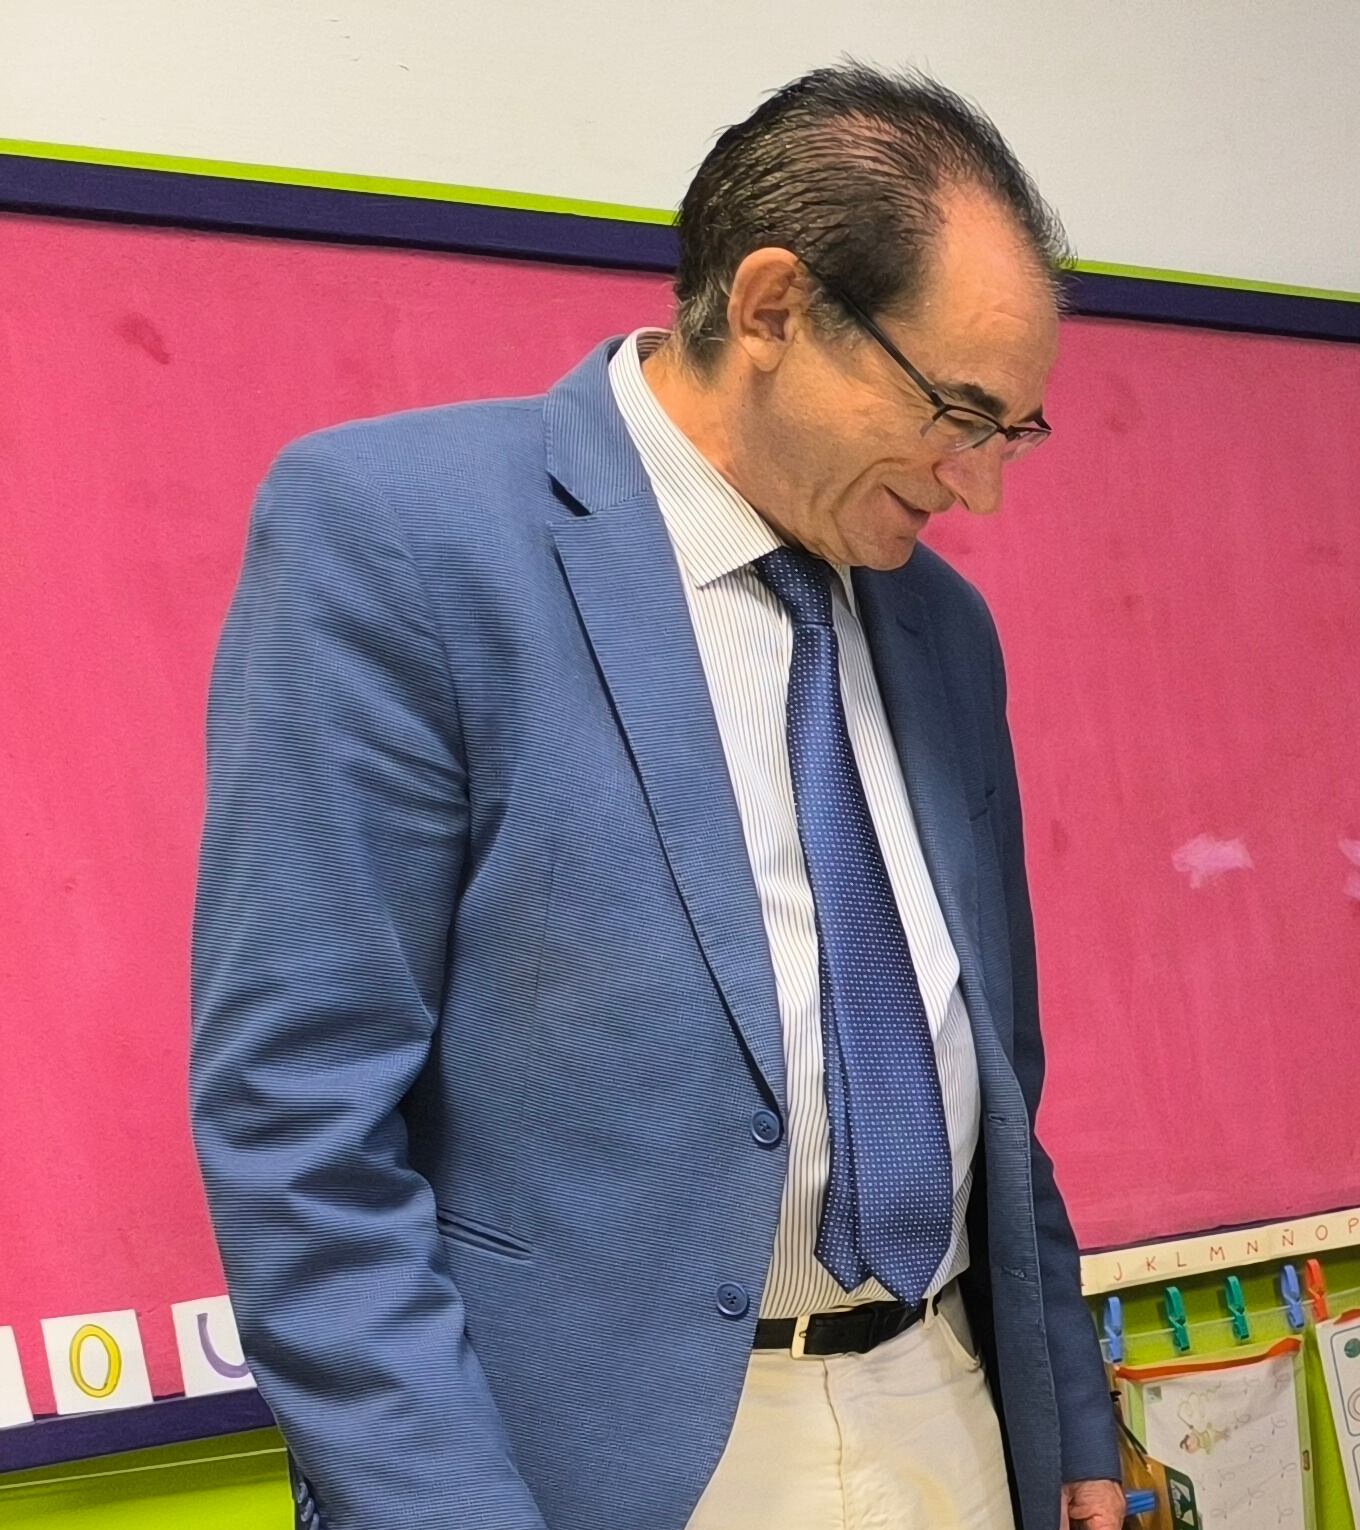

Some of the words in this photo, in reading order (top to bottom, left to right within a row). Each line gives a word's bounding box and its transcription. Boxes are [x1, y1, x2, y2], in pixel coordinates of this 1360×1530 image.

[1145, 1256, 1157, 1272] K
[1176, 1250, 1188, 1268] L
[1209, 1245, 1226, 1262] M
[1246, 1239, 1259, 1256] N
[1347, 1216, 1360, 1234] P
